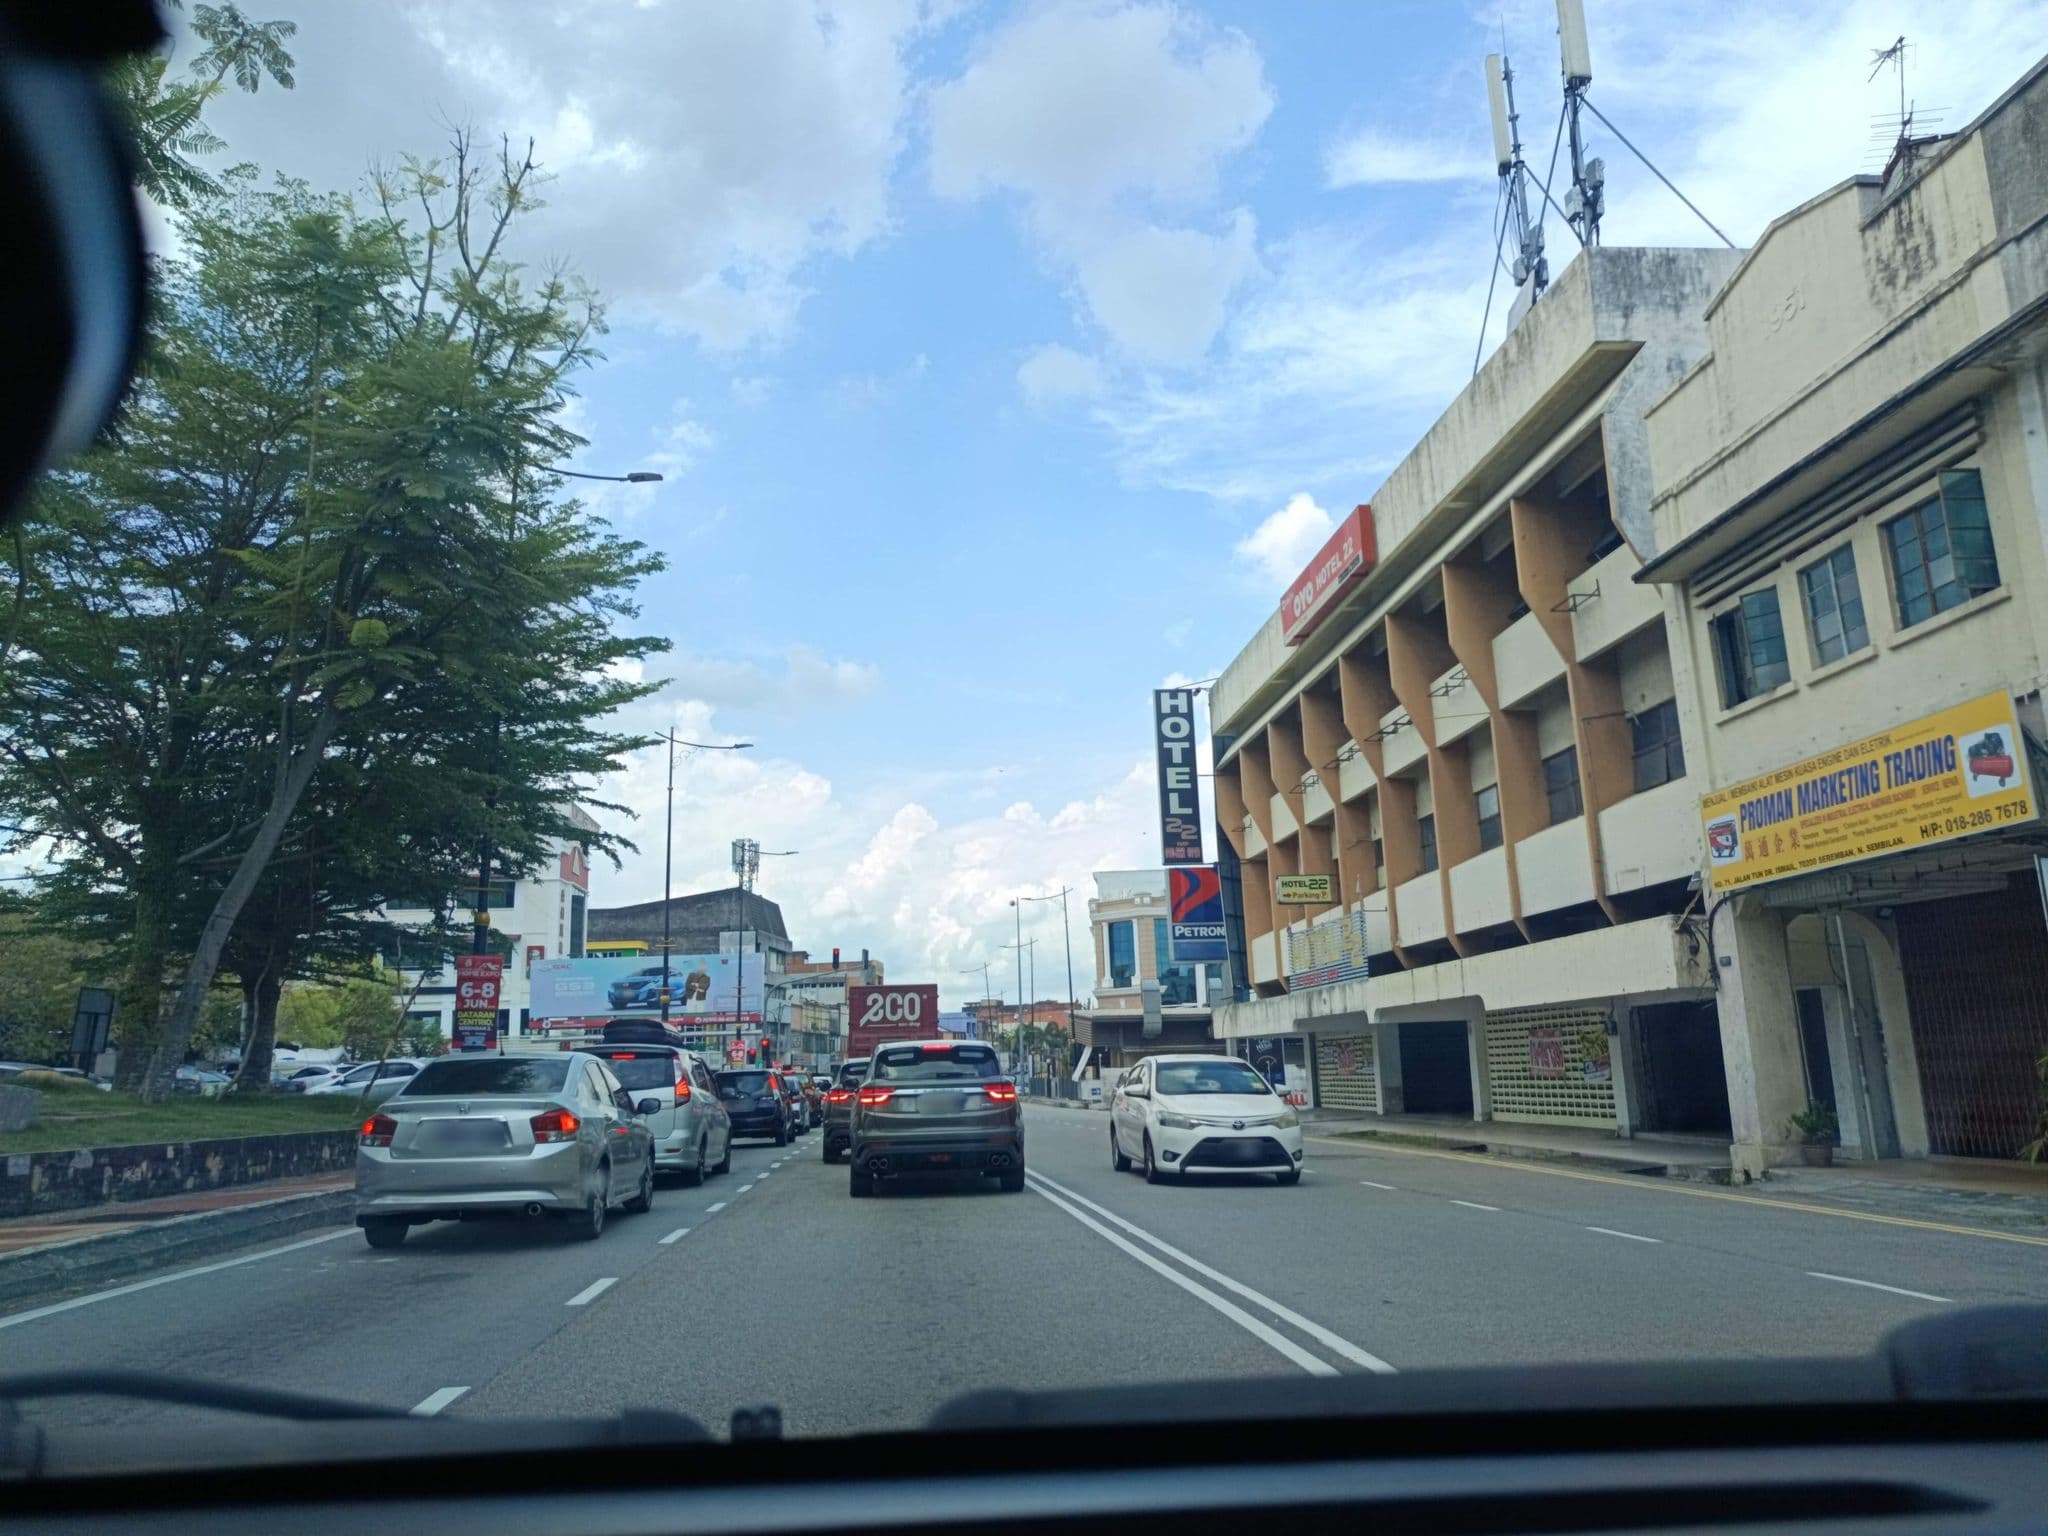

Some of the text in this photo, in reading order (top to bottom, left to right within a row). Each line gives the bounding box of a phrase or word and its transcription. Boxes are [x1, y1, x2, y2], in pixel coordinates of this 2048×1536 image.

[1293, 581, 1314, 618] OYO
[1316, 554, 1342, 591] HOTEL
[1343, 536, 1354, 560] 22
[1160, 691, 1192, 815] HOTEL
[1740, 786, 1794, 834] PROMAN
[1797, 759, 1881, 816] MARKETING
[1883, 734, 1957, 790] TRADING
[1165, 817, 1198, 840] 22
[1920, 822, 1943, 839] H/P:
[1945, 808, 1993, 833] 018-286
[1995, 799, 2028, 821] 7678
[1281, 878, 1328, 890] HOTEL 22
[1174, 926, 1226, 937] PETRON
[461, 981, 495, 998] 6-8
[463, 998, 488, 1008] JUN
[458, 1010, 495, 1018] DATARAN
